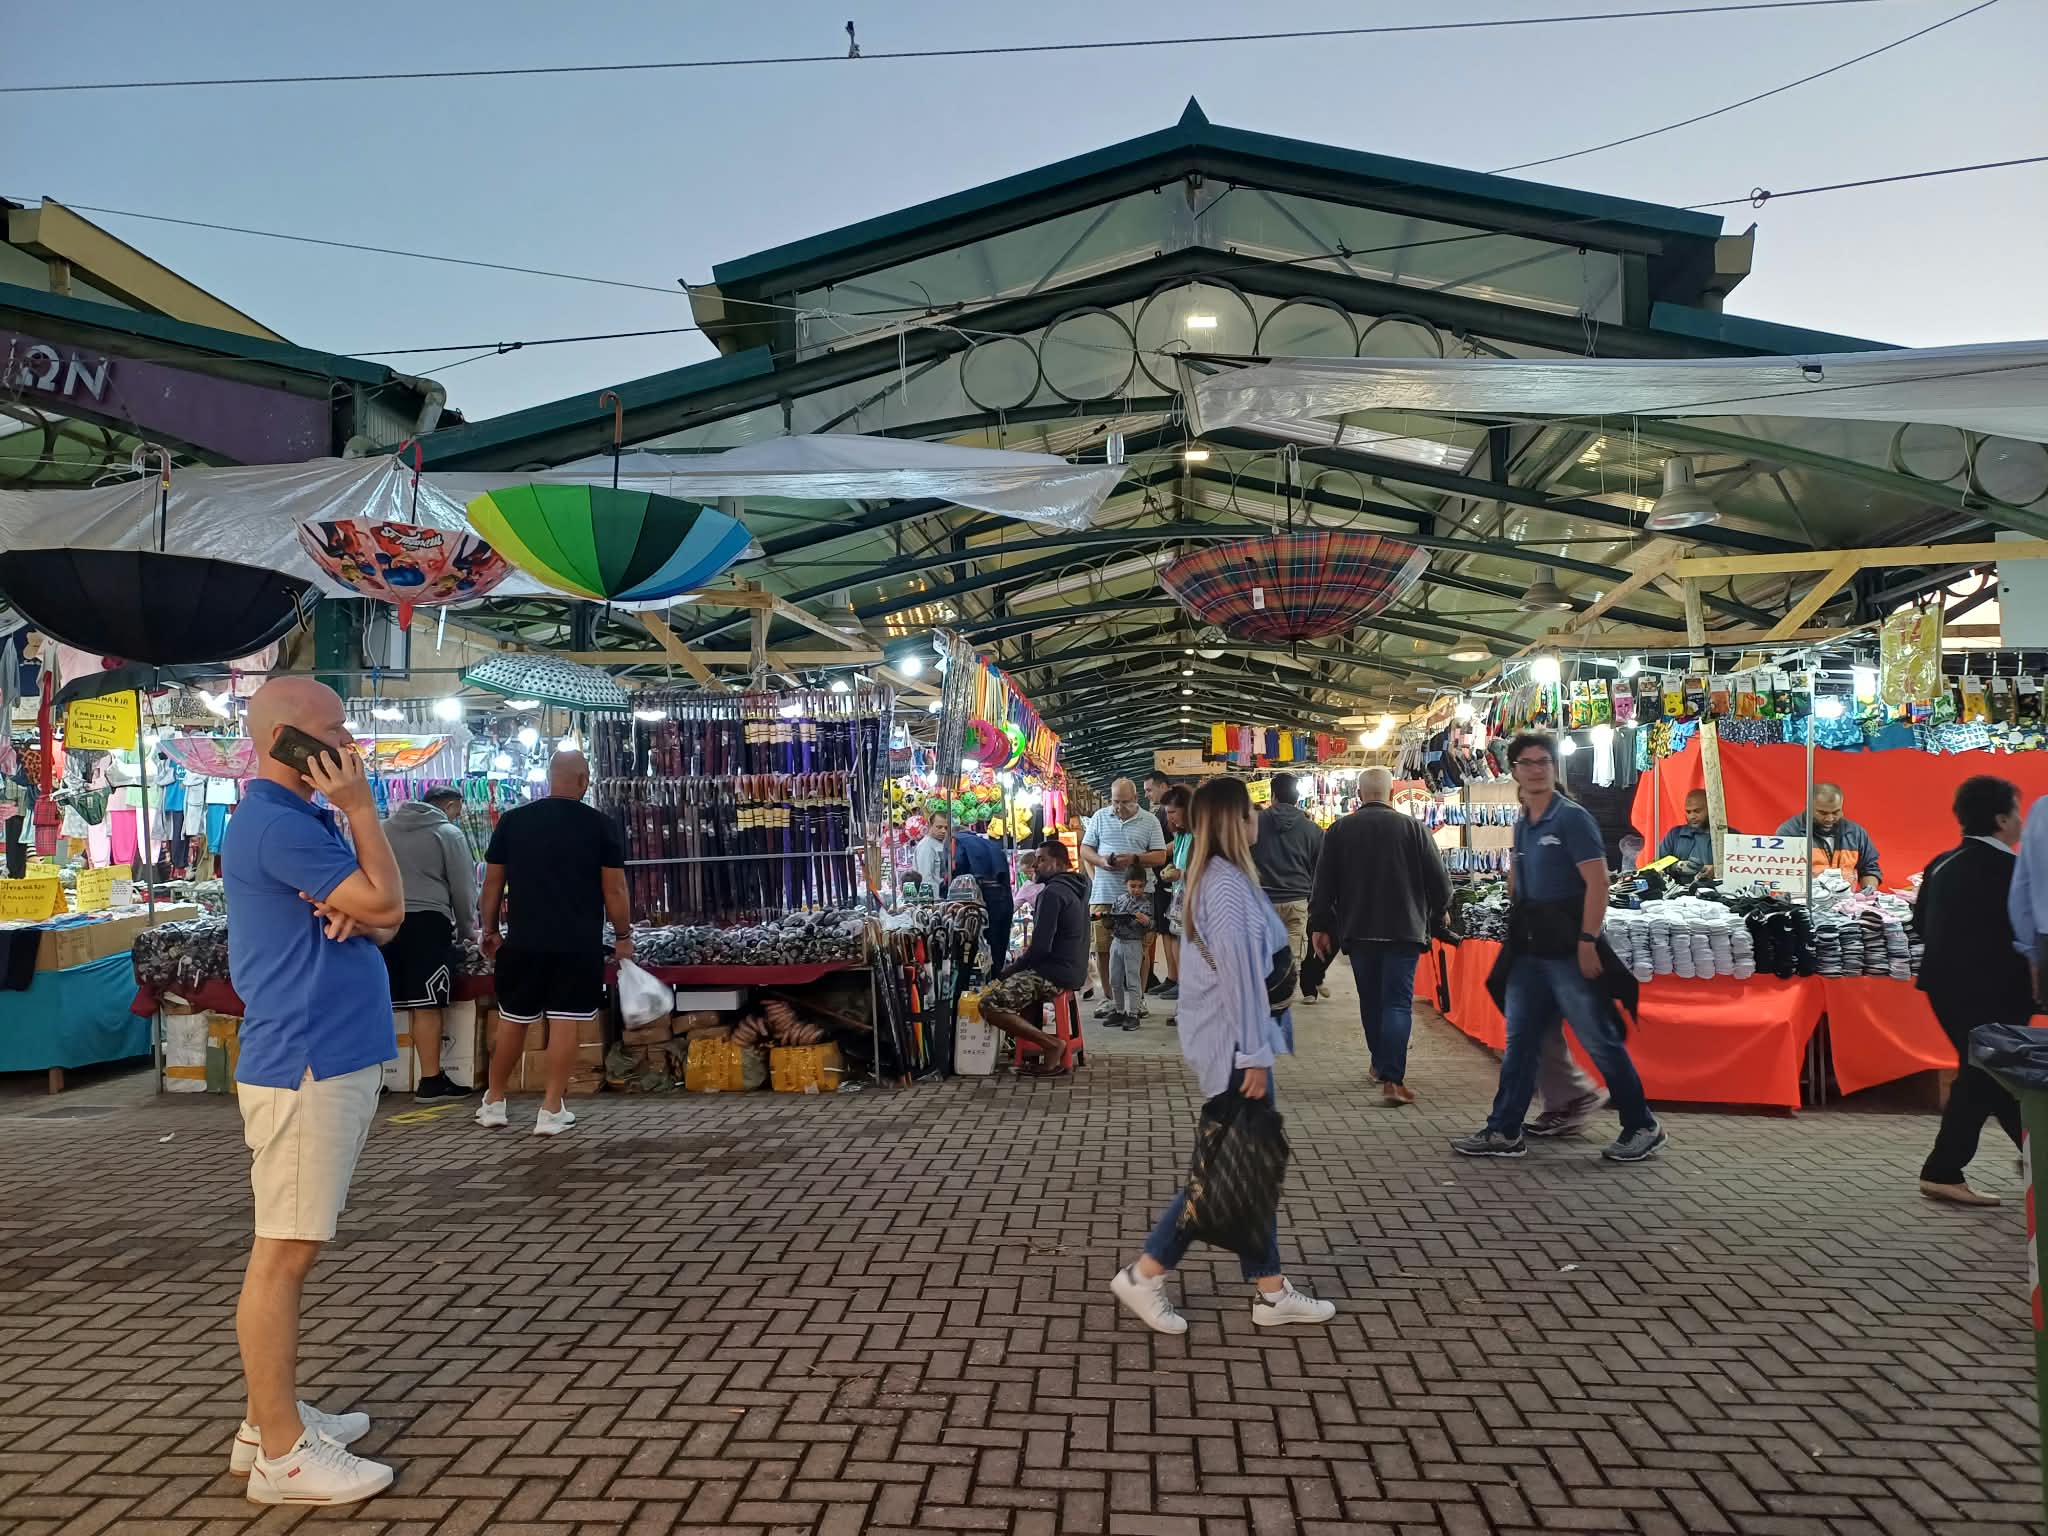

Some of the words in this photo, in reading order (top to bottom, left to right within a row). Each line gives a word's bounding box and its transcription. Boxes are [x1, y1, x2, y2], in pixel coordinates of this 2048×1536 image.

[1751, 837, 1785, 849] 12
[1726, 853, 1808, 864] ΖΕΥΓΑΡΙΑ
[1729, 865, 1806, 877] ΚΑΛΤΣΕΣ
